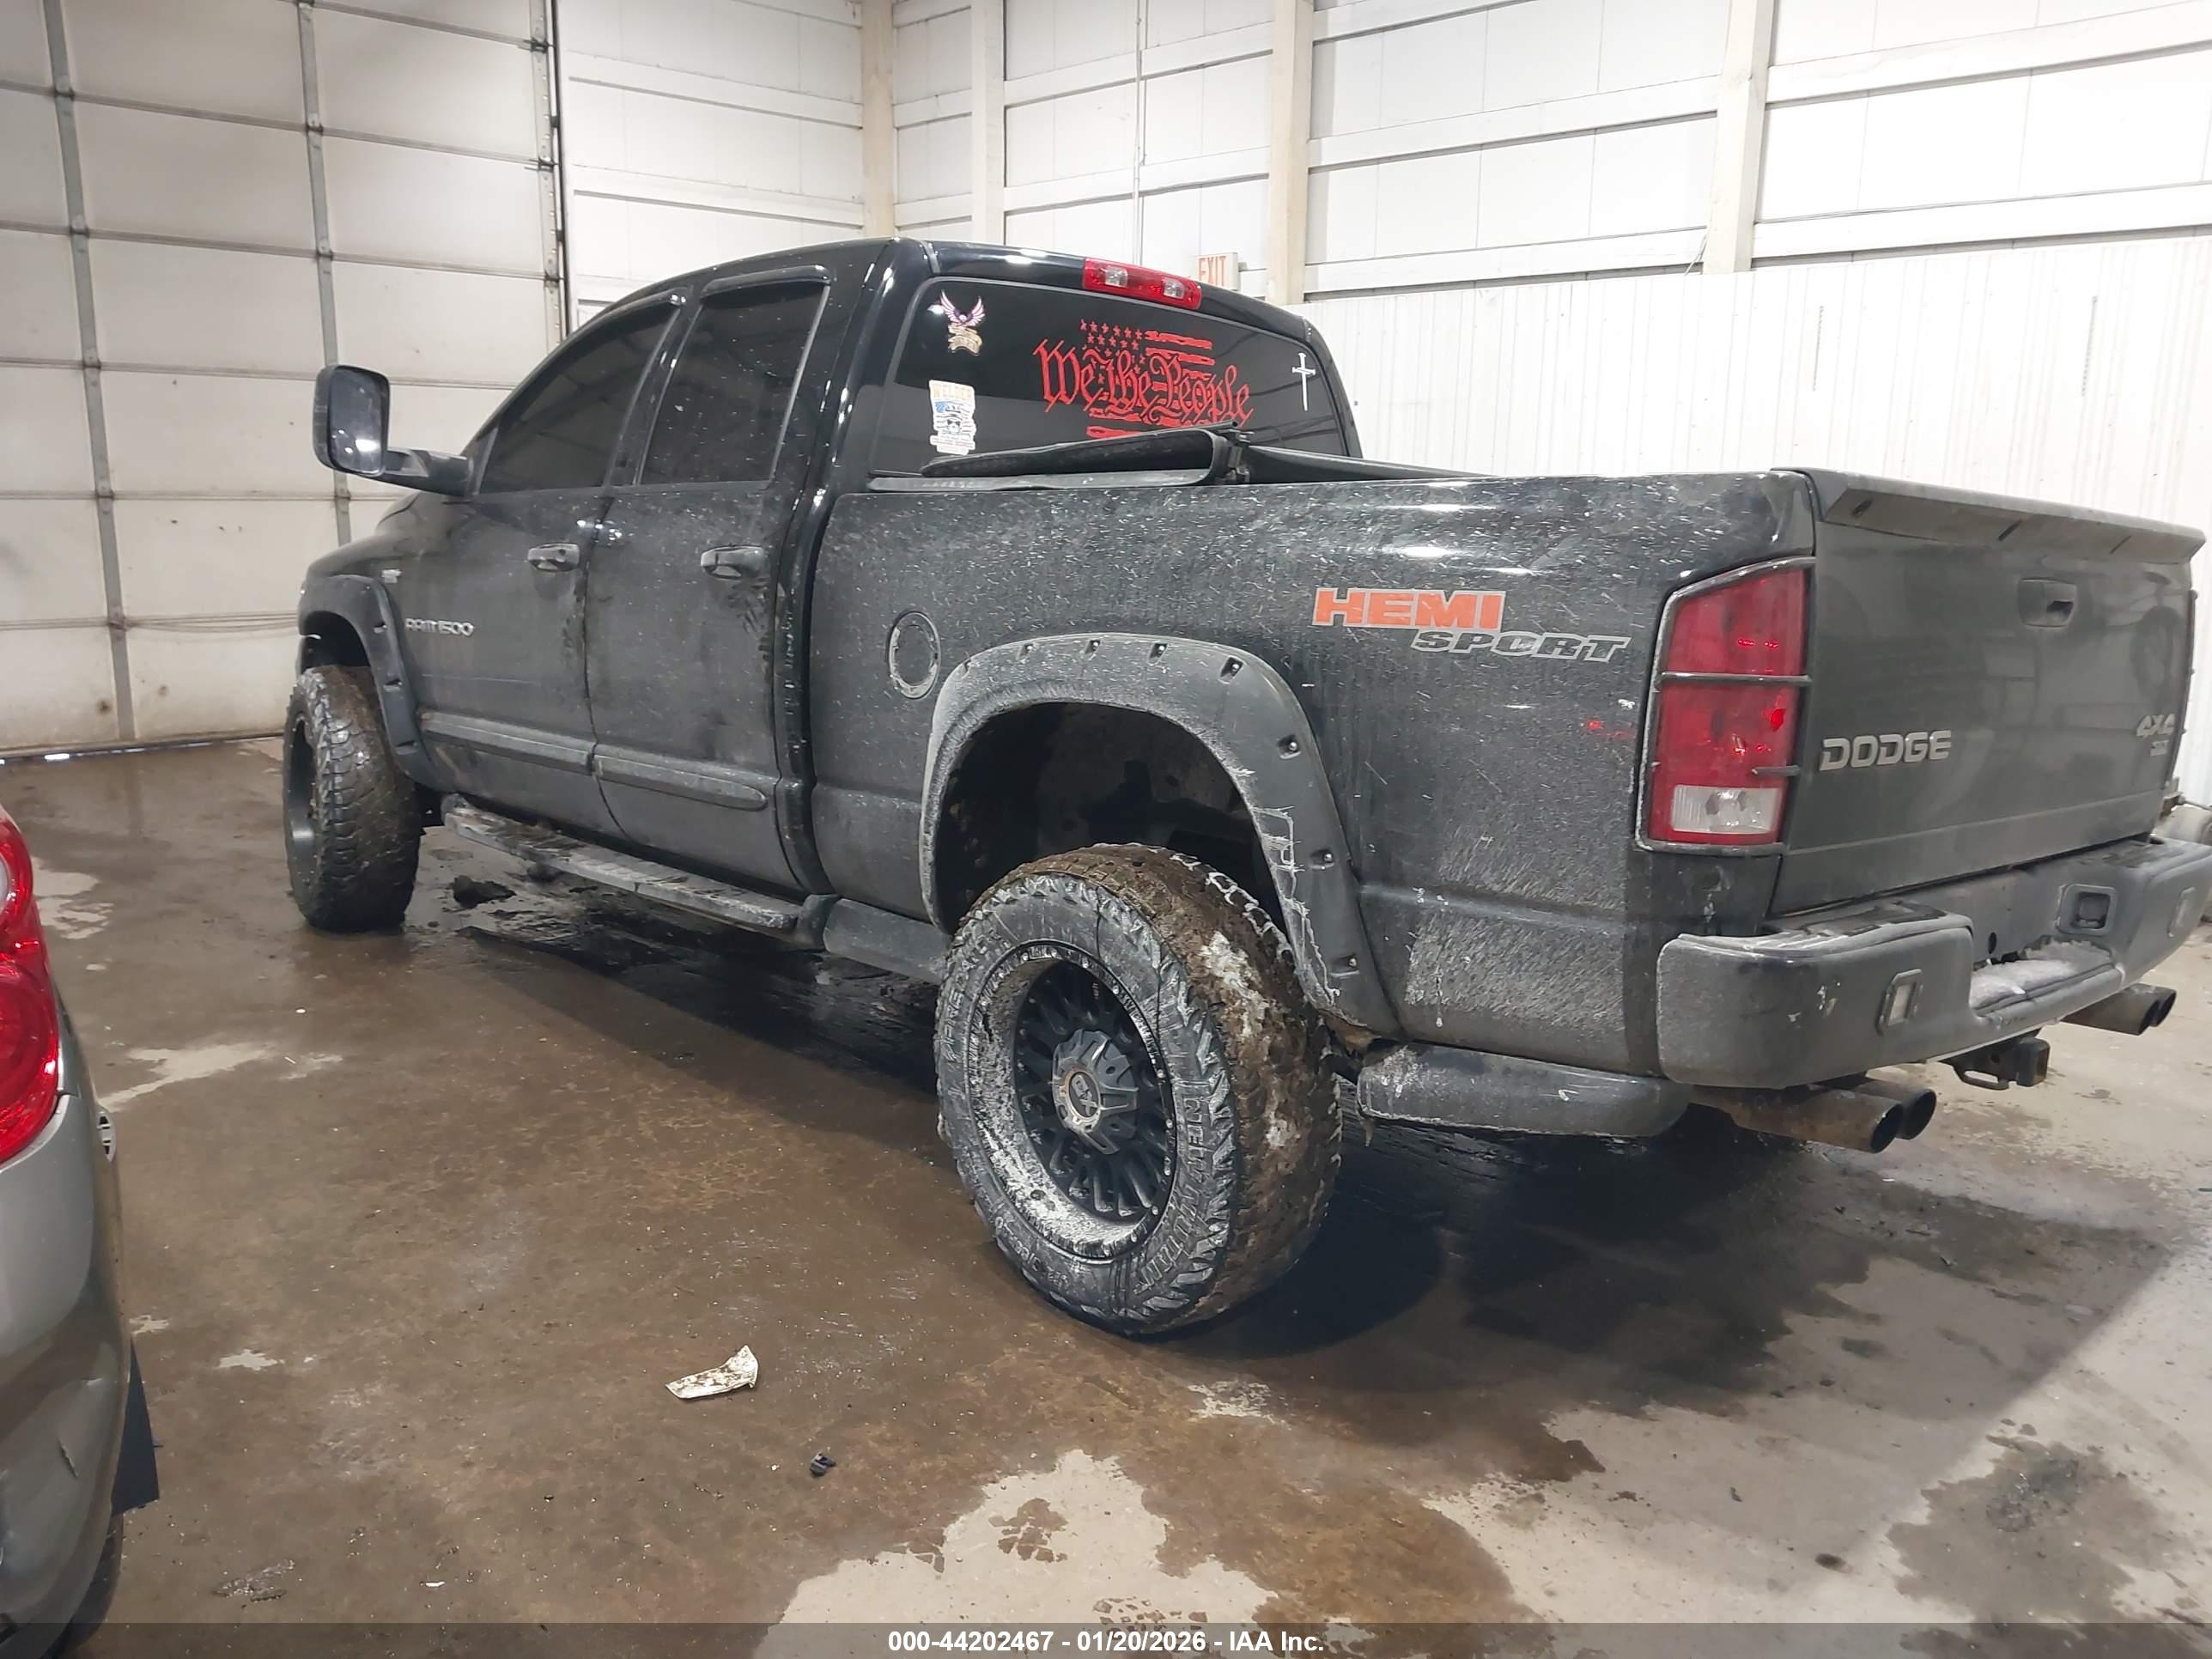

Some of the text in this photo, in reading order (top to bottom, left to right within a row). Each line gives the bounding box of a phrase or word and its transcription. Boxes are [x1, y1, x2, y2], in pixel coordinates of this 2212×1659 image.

[1198, 255, 1226, 287] EXIT
[1033, 338, 1103, 413] We
[1149, 354, 1255, 427] People
[1312, 587, 1506, 630] HEMI
[1410, 630, 1632, 662] SPORT
[1820, 730, 1952, 771] DODGE
